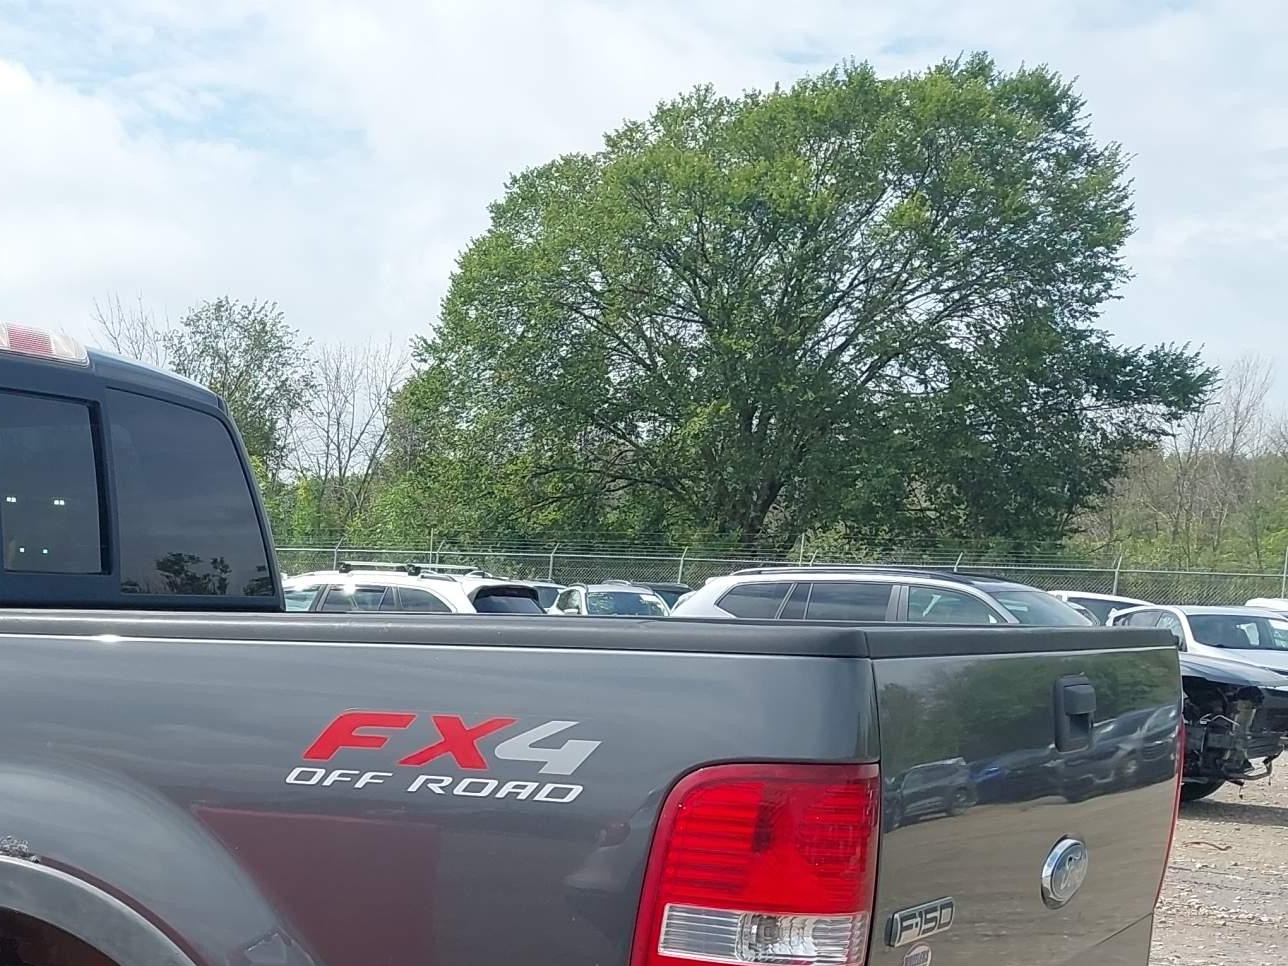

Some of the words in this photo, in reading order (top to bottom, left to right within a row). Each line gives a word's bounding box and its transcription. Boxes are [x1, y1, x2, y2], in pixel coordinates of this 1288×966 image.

[302, 711, 602, 776] FX4
[285, 767, 393, 788] OFF
[407, 775, 584, 803] ROAD
